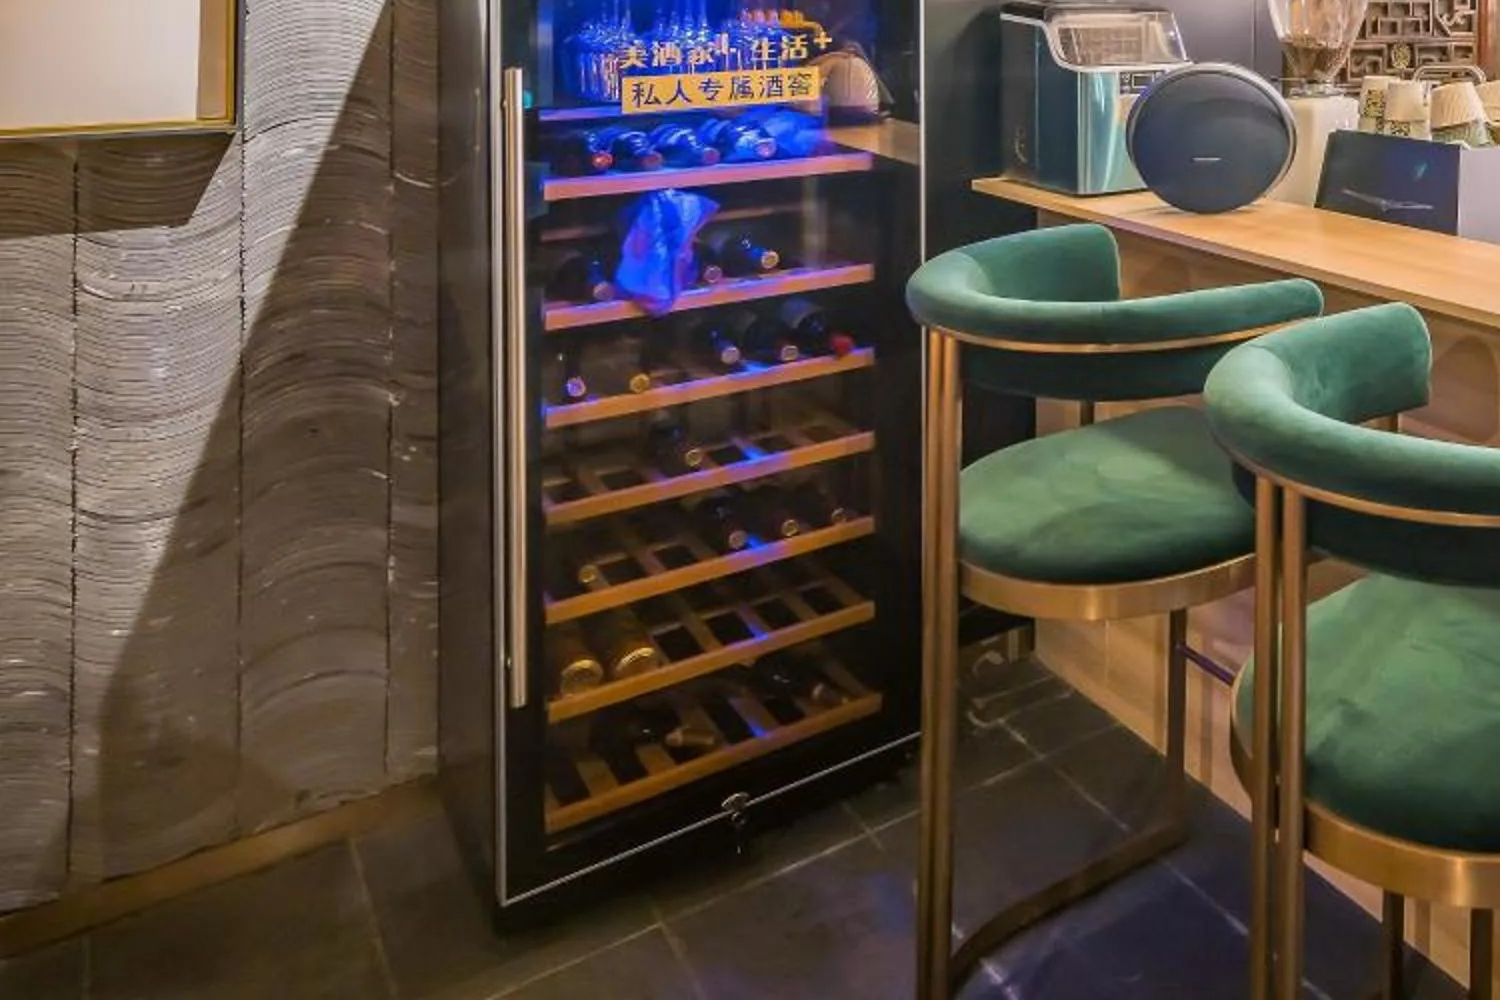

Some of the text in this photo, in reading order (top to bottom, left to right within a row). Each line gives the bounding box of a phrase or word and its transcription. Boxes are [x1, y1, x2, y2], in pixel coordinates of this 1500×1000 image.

[631, 72, 814, 108] 私人专属酒窖
